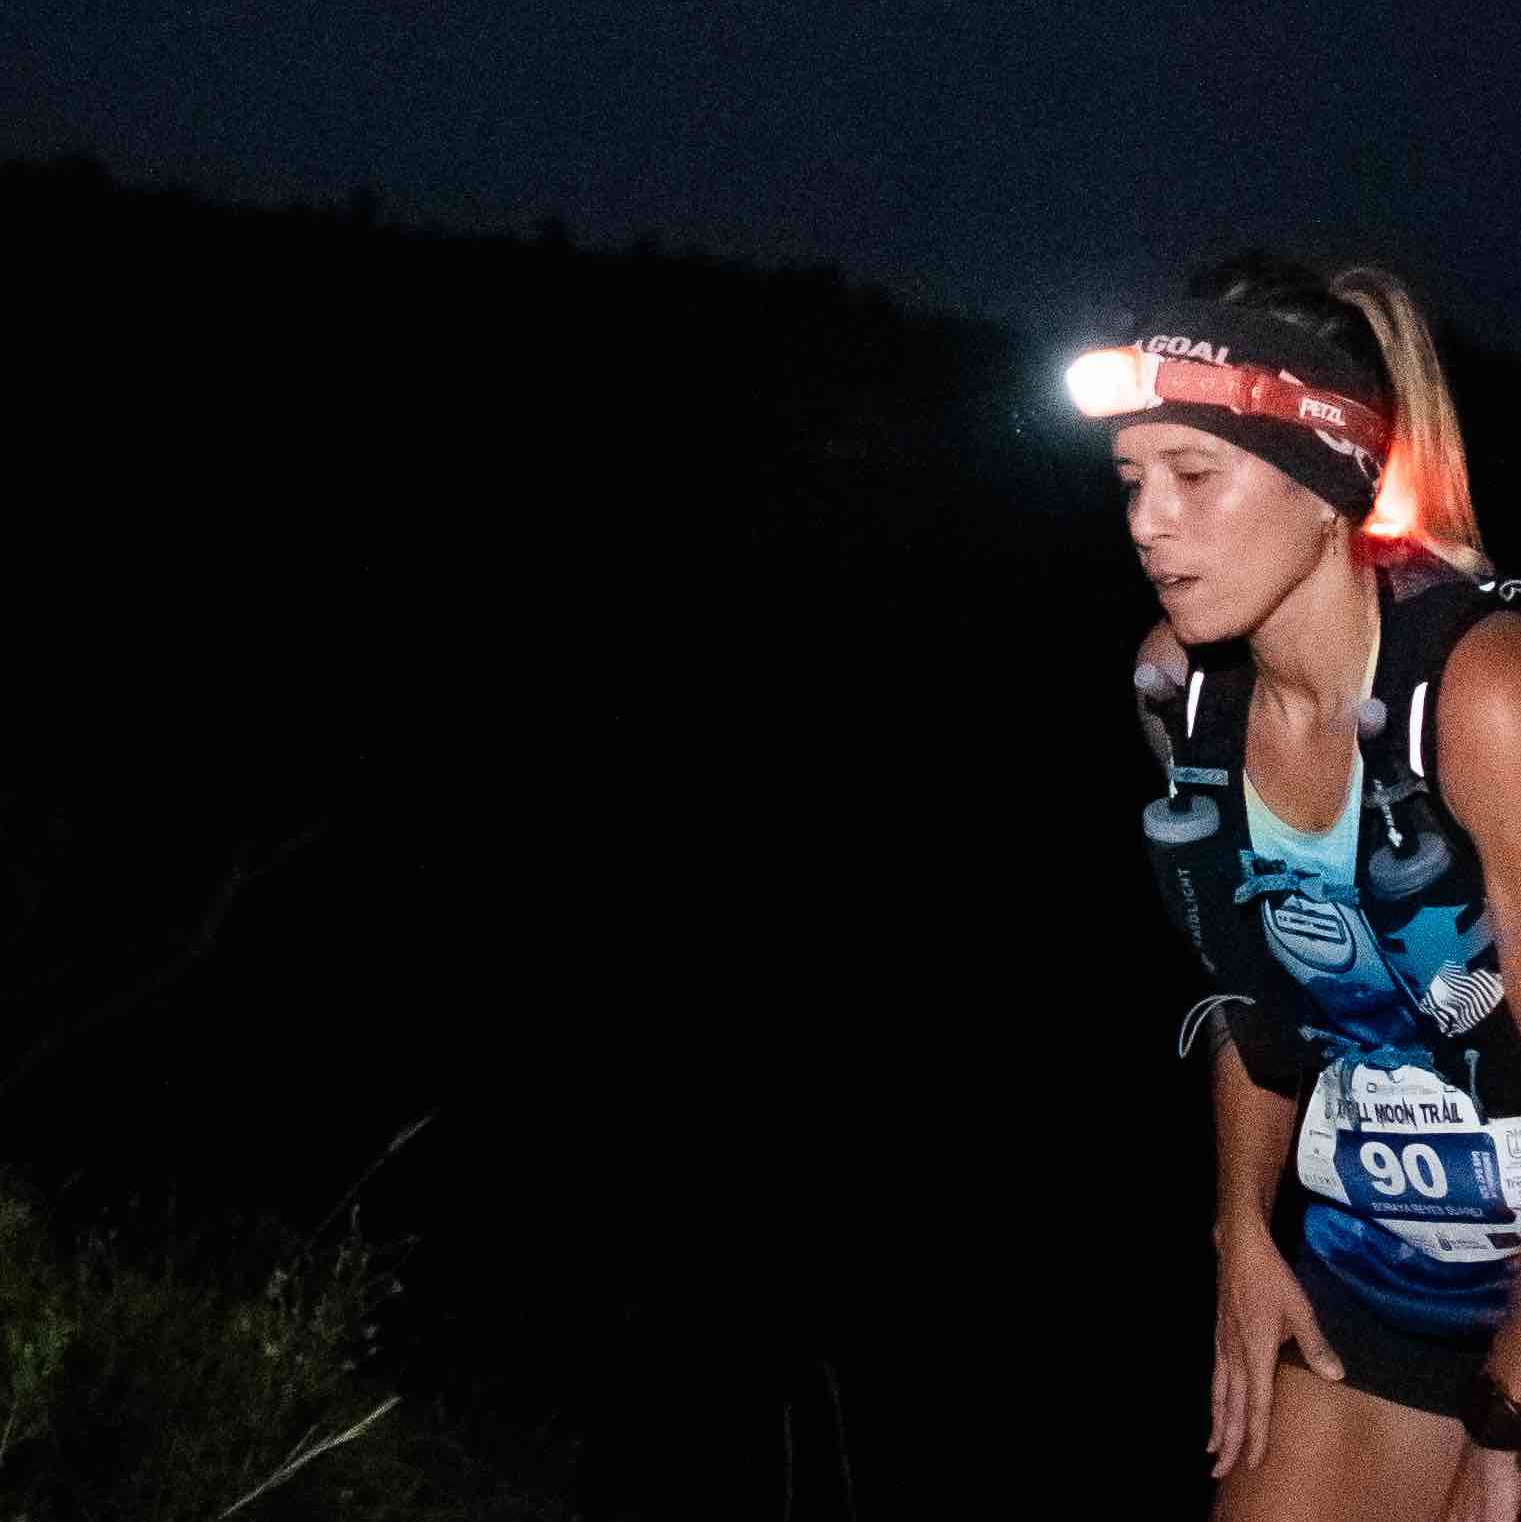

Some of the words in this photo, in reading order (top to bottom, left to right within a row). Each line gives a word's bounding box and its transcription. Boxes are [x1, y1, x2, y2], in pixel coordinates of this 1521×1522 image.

[1375, 1098, 1418, 1130] MOON
[1420, 1098, 1464, 1124] TRAIL
[1360, 1141, 1448, 1198] 90
